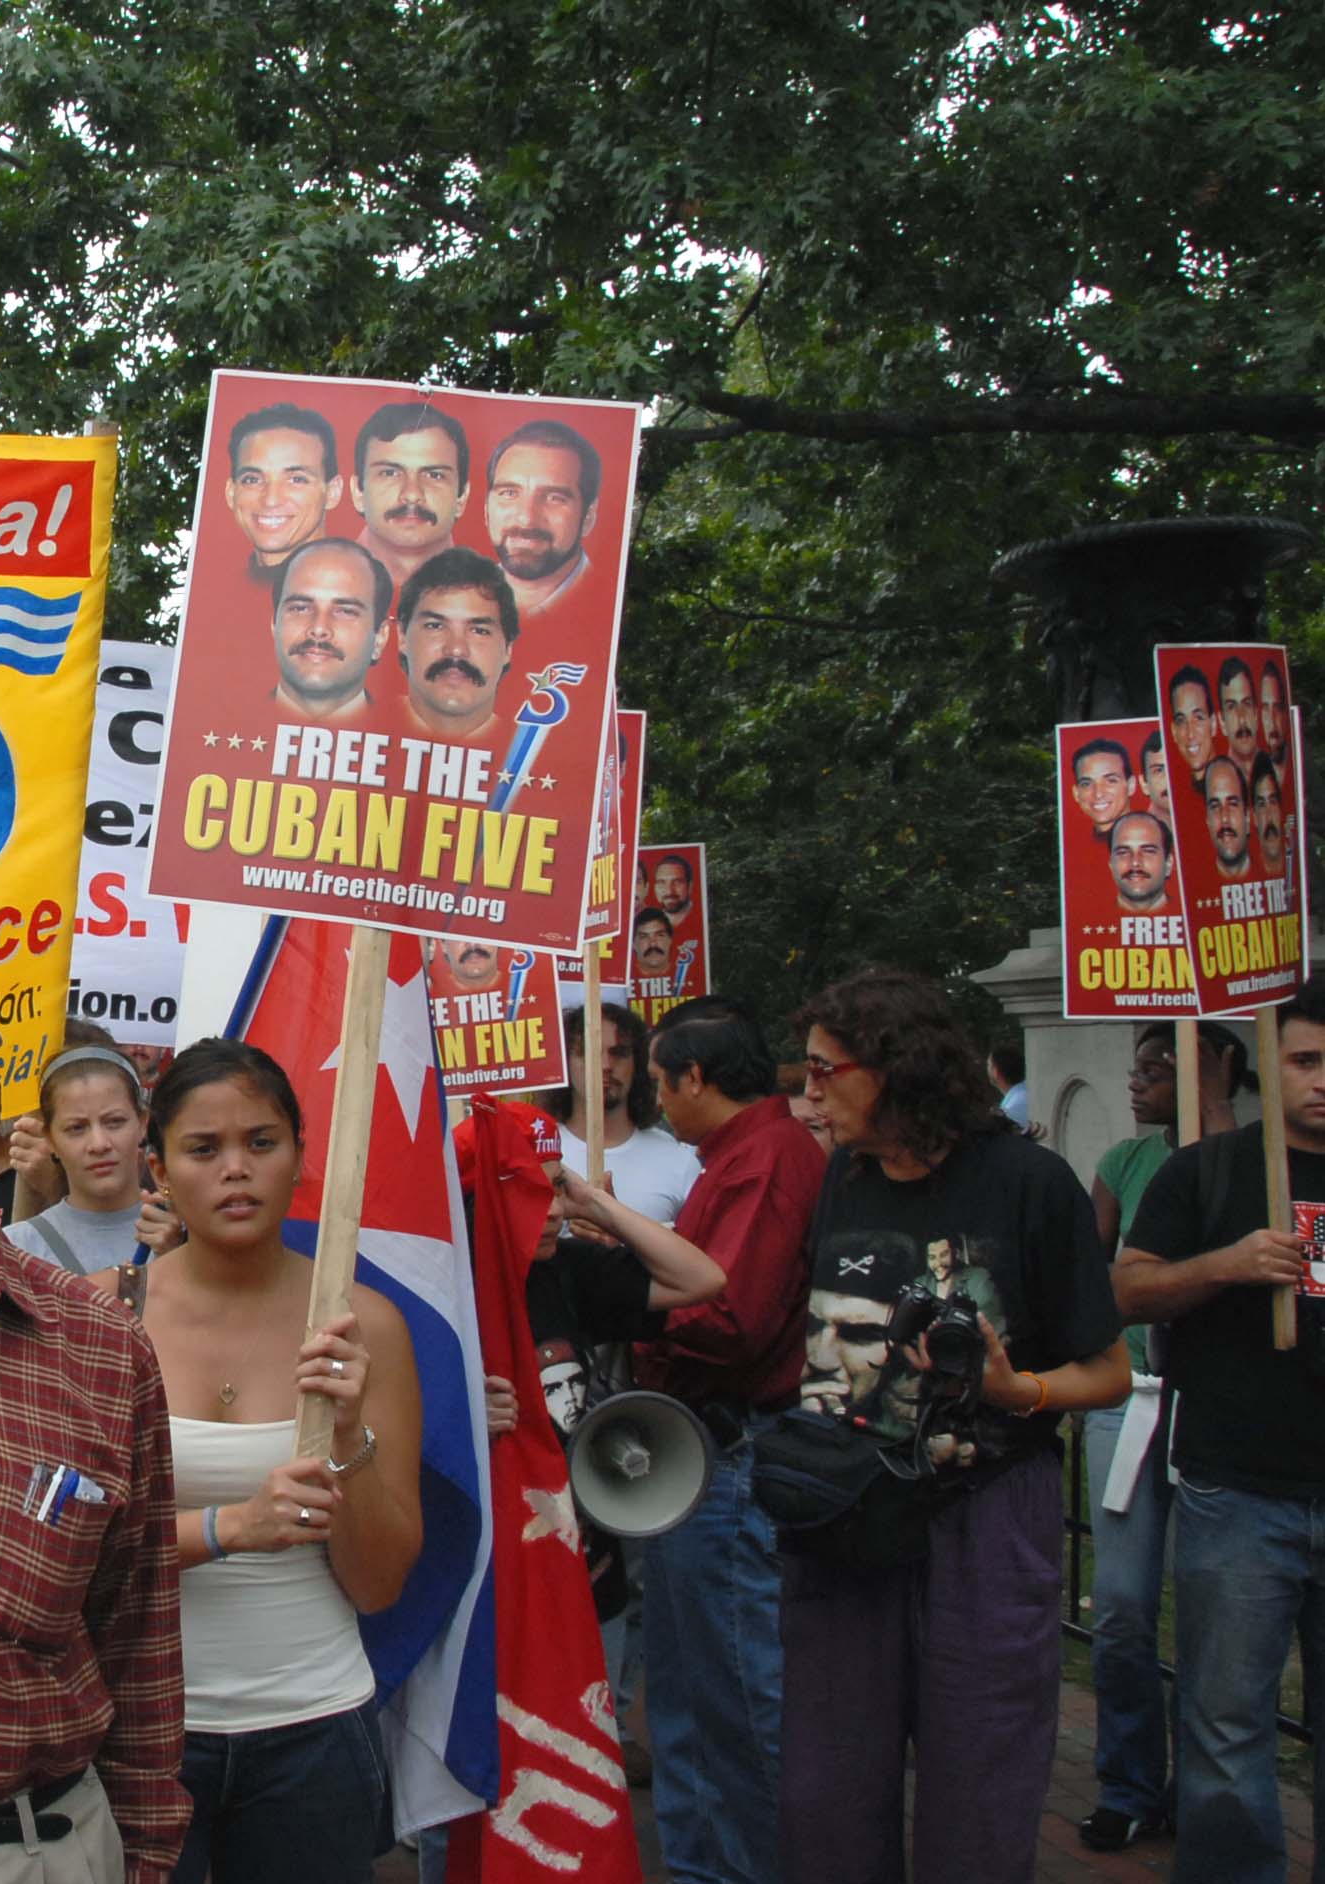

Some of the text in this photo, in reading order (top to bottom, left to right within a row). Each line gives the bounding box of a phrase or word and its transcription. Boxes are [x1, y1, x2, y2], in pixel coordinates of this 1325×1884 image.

[271, 723, 493, 803] FREE THE
[183, 774, 406, 873] CUBAN
[420, 802, 559, 895] FIVE
[242, 864, 506, 923] www.freethefive.org
[1221, 878, 1287, 921] FREE THE
[1120, 915, 1184, 946] FREE
[1197, 918, 1276, 979] CUBAN
[638, 976, 672, 998] THE
[1078, 947, 1195, 990] CUBAN
[452, 989, 506, 1026] THE
[475, 1017, 547, 1066] FIVE
[442, 1066, 526, 1087] ethefive.org
